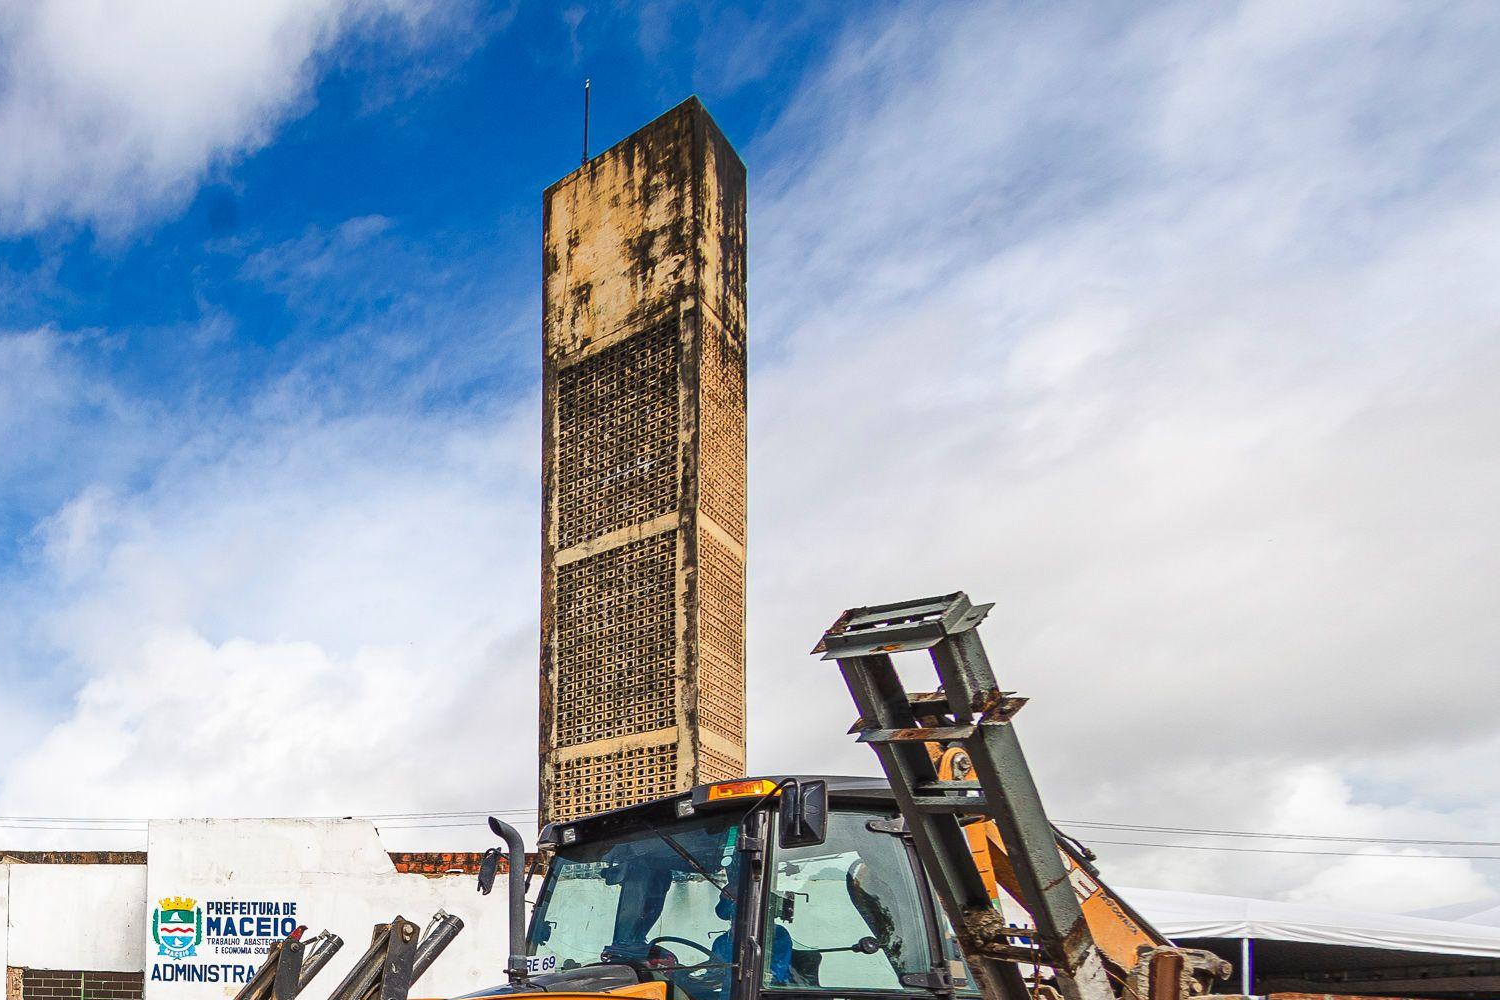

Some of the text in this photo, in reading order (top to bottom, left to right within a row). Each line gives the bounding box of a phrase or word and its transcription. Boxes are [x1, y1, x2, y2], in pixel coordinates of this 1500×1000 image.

[206, 901, 296, 915] PREFEITURA DE
[207, 937, 240, 946] TRABALHO
[215, 946, 219, 955] E
[221, 946, 252, 955] ECONOMIA
[542, 956, 556, 971] 69
